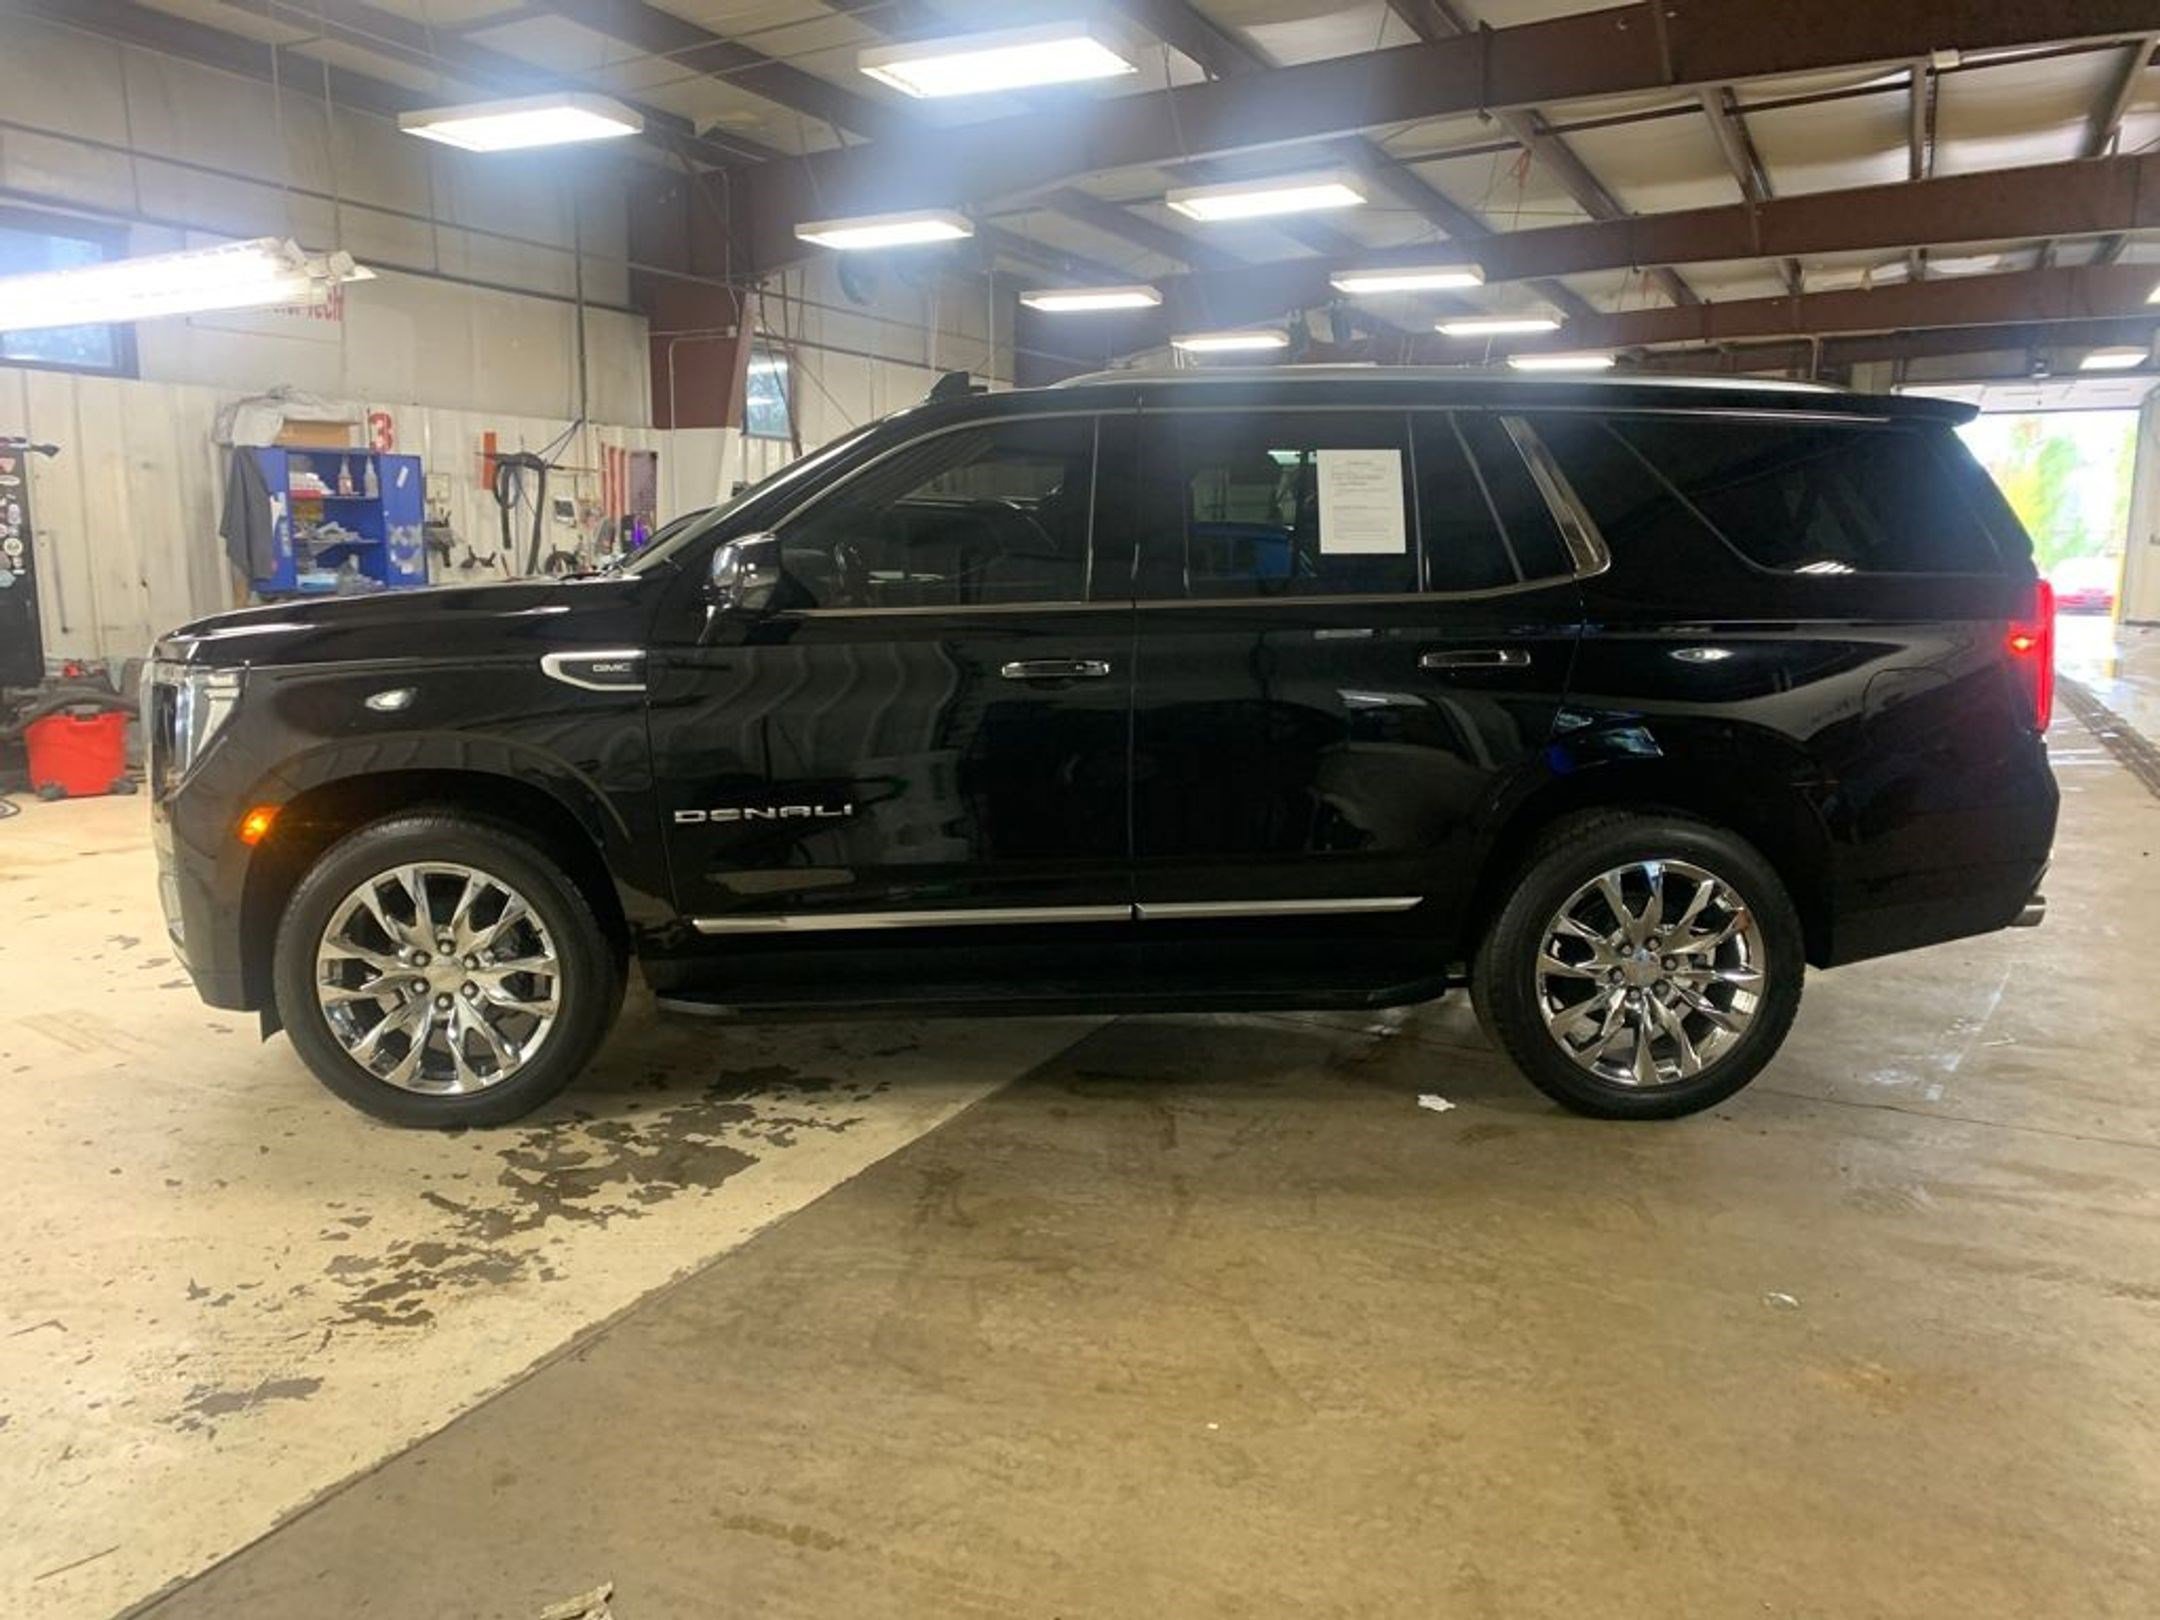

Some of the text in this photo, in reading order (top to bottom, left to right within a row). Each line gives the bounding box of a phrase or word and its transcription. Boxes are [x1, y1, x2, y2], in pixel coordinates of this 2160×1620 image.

[368, 413, 393, 454] 3
[592, 662, 632, 673] GMC
[675, 804, 852, 822] DENALI
